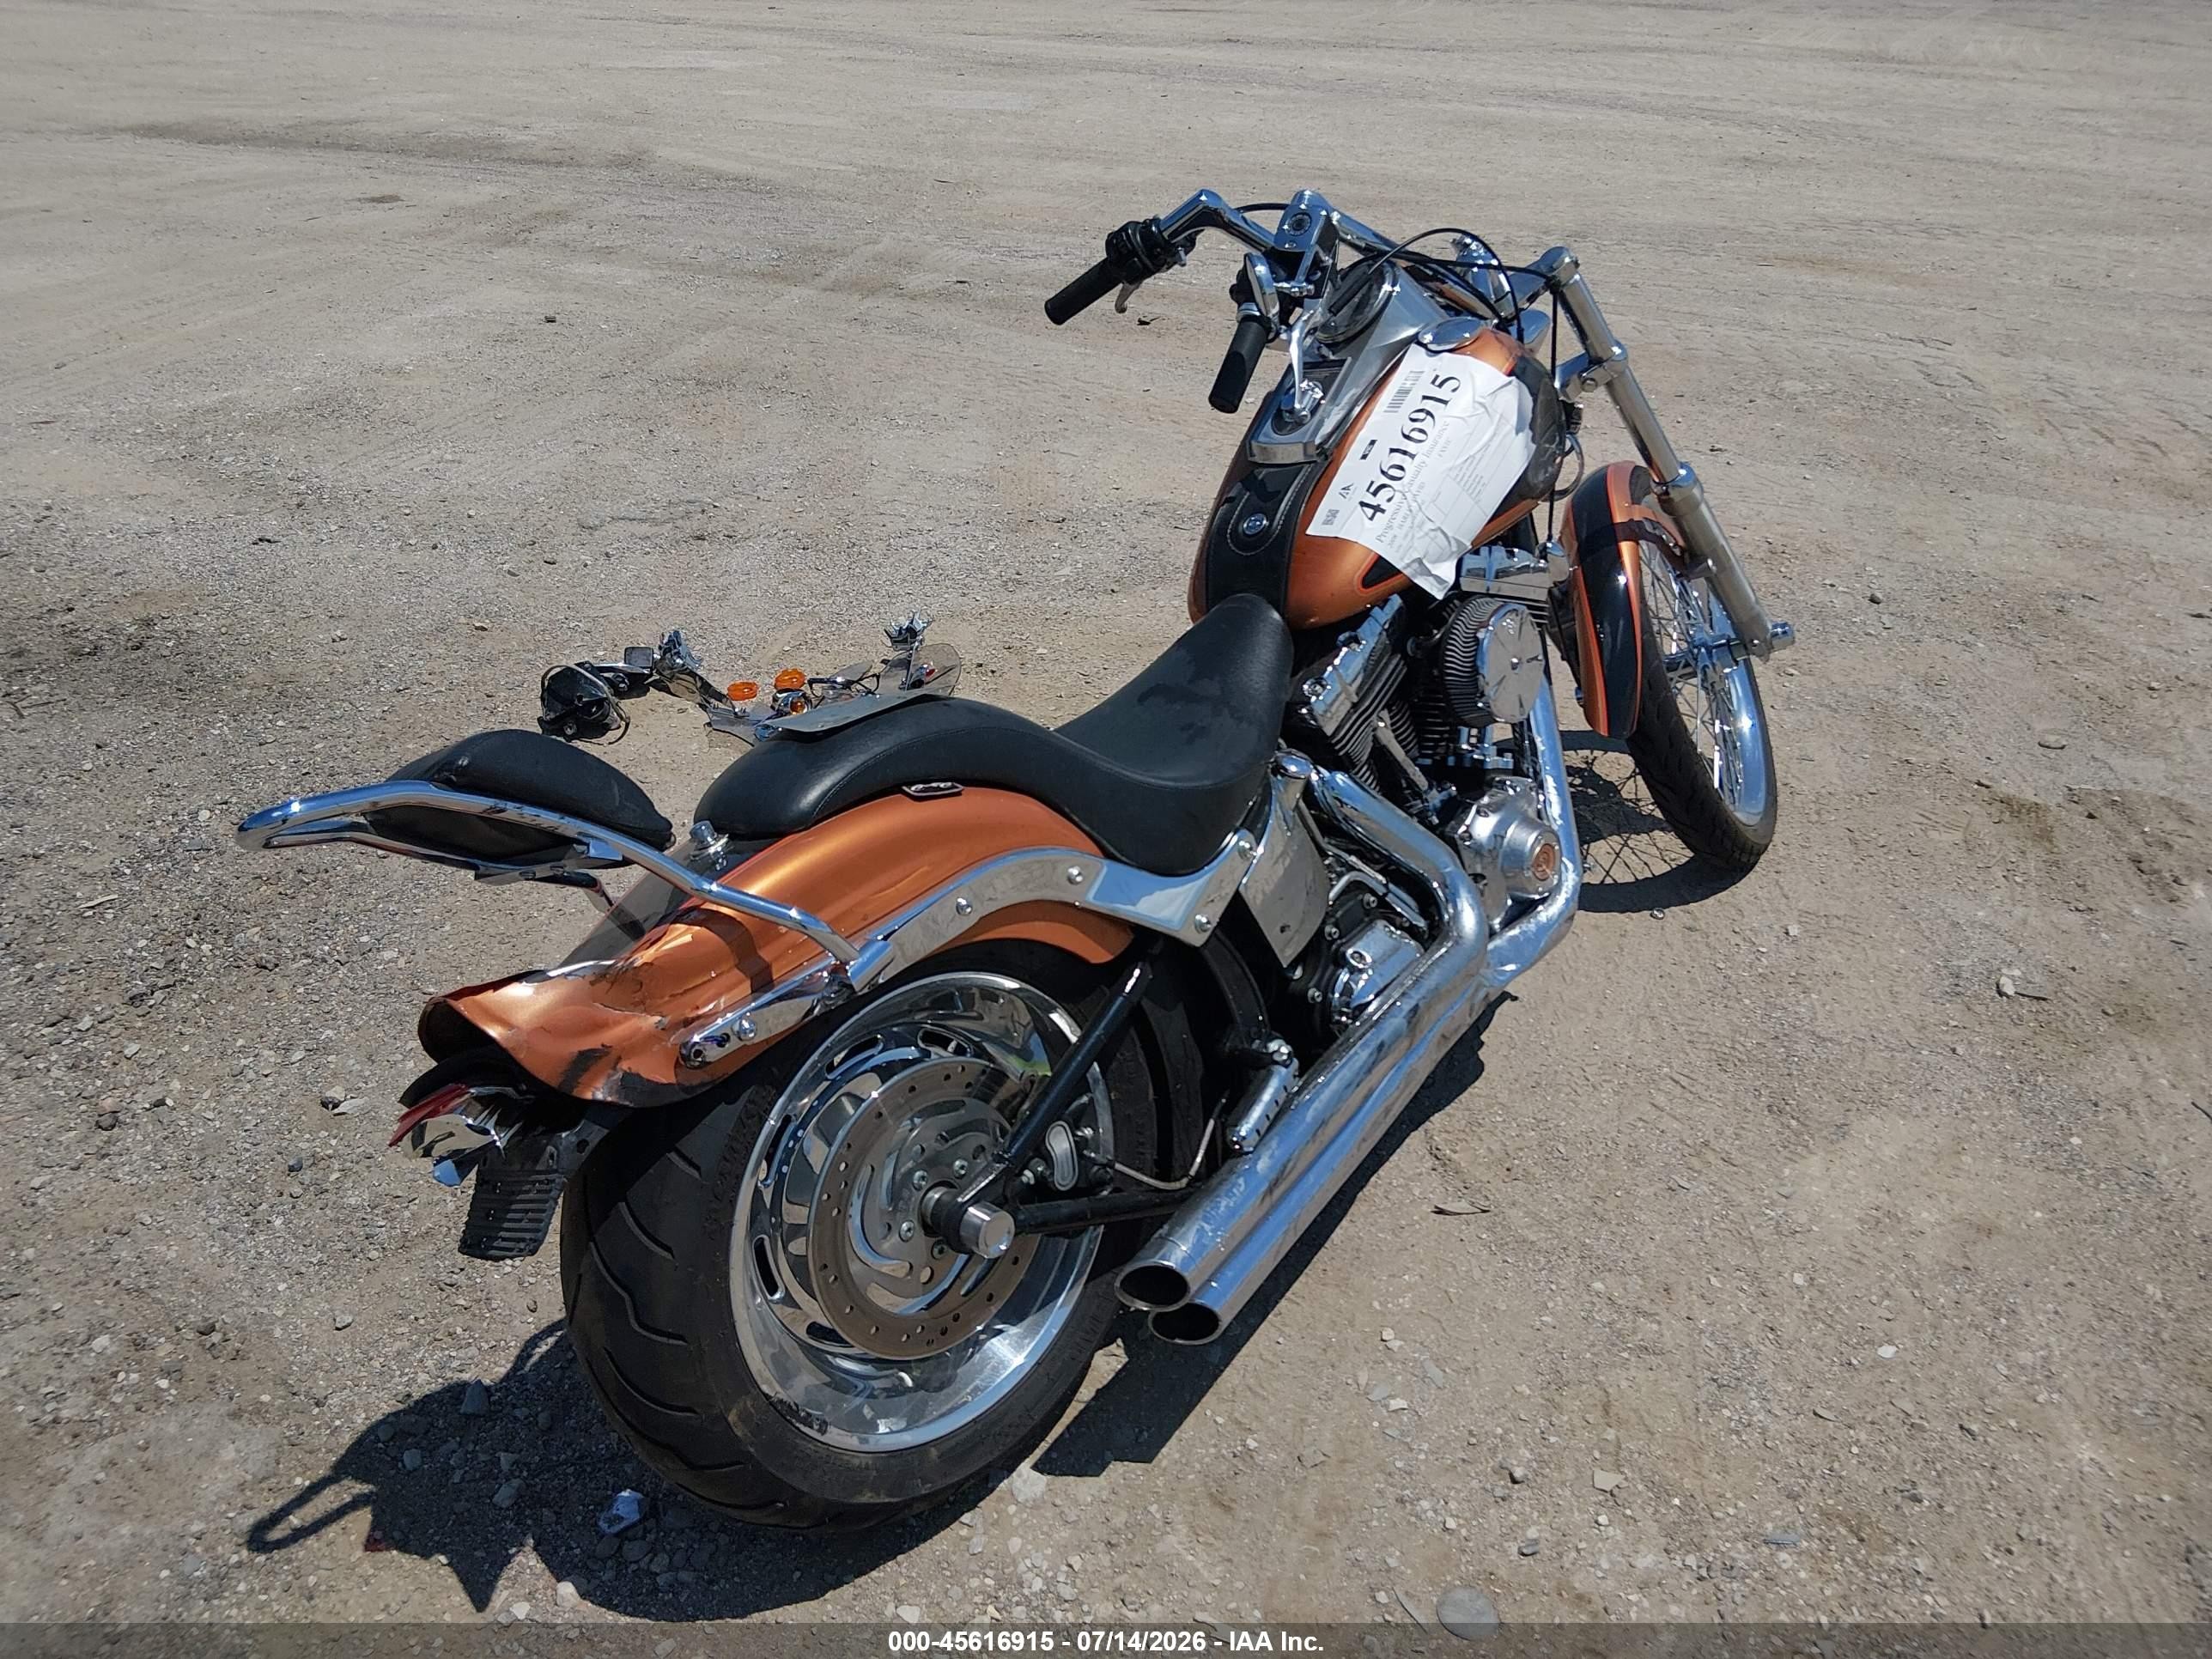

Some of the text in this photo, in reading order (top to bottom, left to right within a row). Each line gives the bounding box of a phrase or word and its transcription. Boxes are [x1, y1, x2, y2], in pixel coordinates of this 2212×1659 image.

[1360, 374, 1460, 522] 45616915
[1403, 460, 1426, 494] Casualty
[1422, 421, 1449, 458] Insurance
